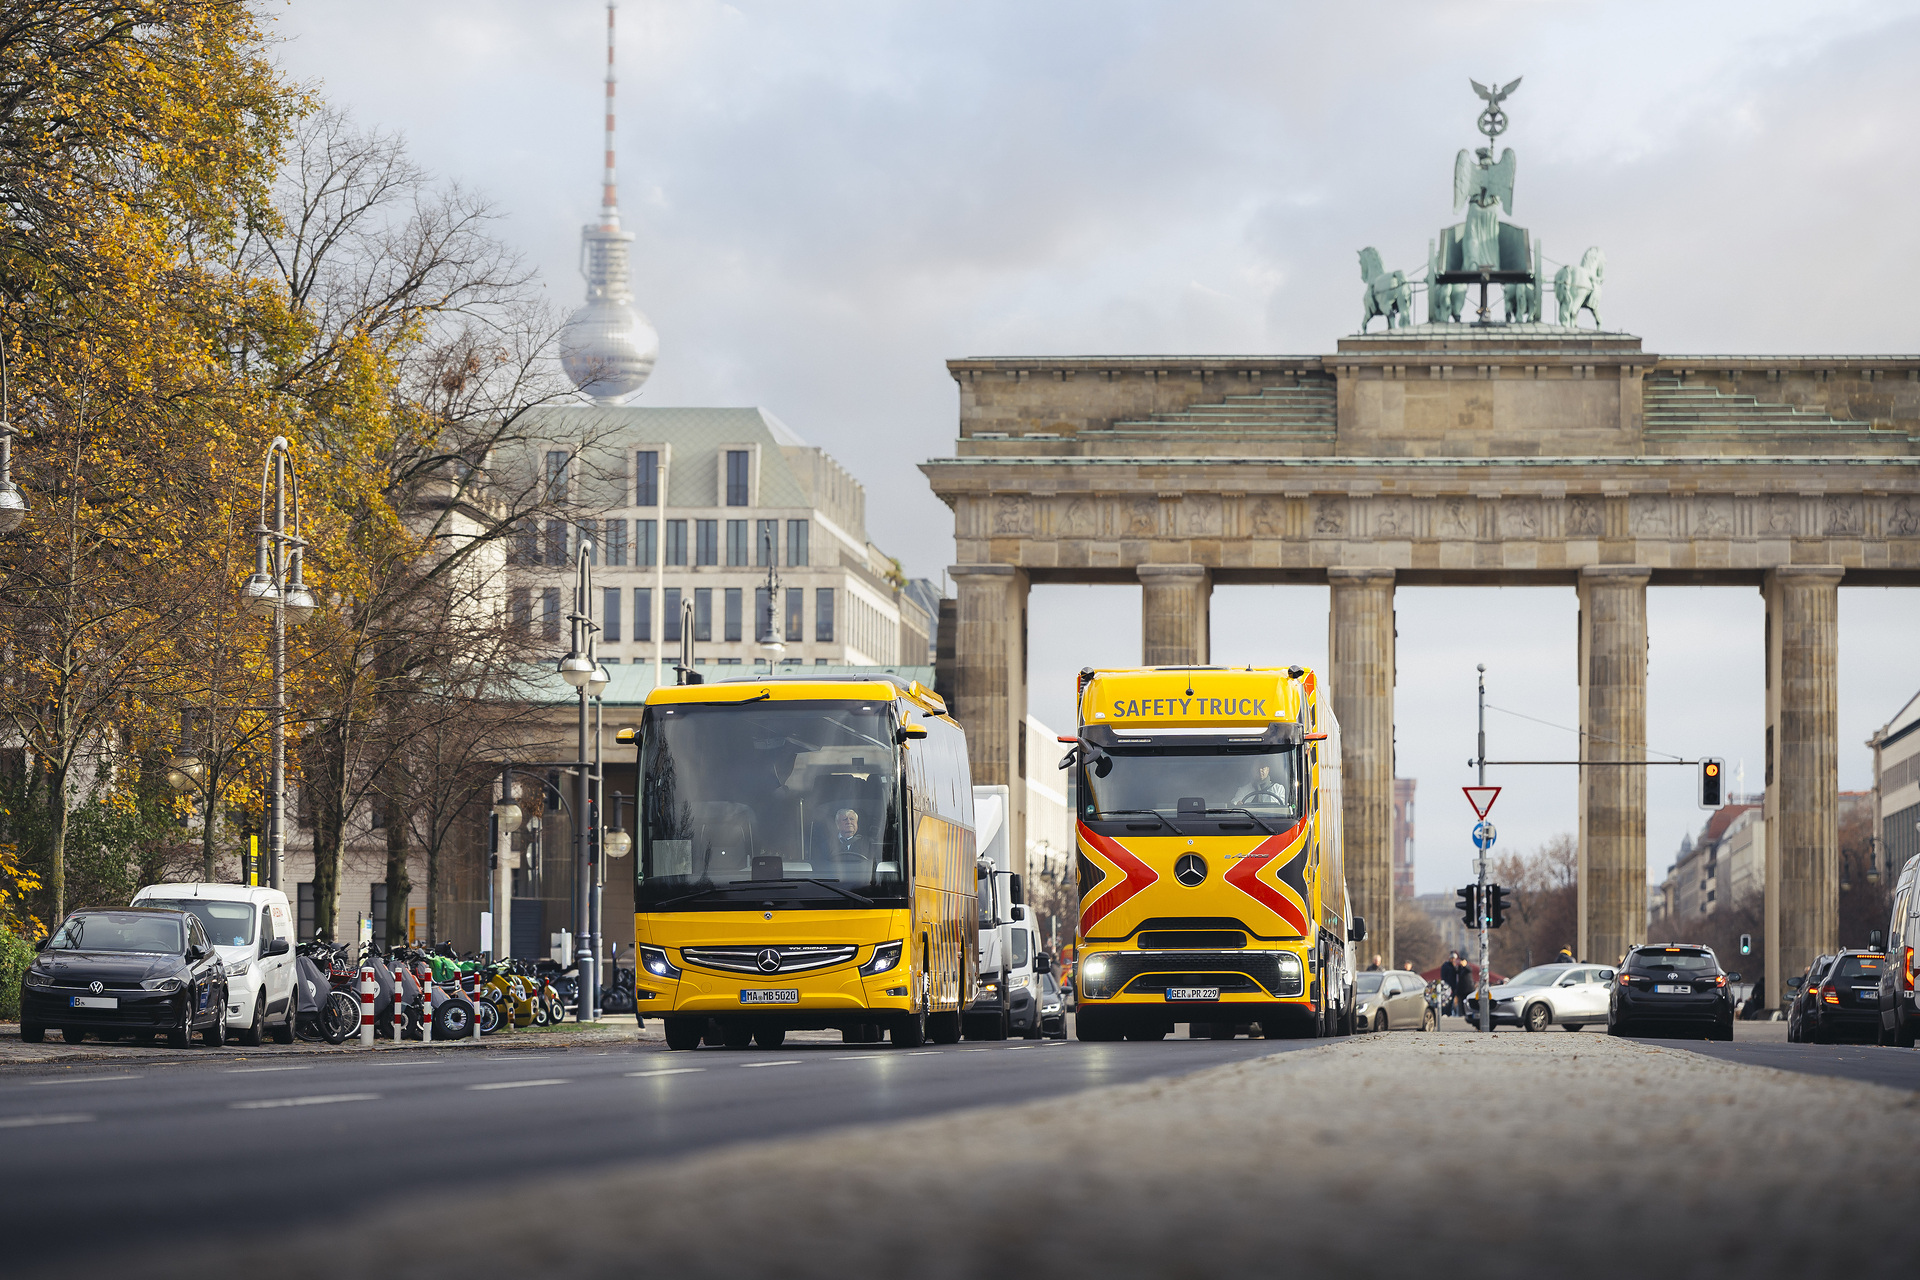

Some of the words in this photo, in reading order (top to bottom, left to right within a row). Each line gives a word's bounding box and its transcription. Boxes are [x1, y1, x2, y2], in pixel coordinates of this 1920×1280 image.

[1113, 698, 1192, 718] SAFETY
[1196, 698, 1267, 717] TRUCK
[746, 991, 758, 1001] MA
[762, 991, 774, 1001] MB
[775, 990, 796, 1000] 5020
[1172, 989, 1186, 998] GER
[1191, 989, 1202, 998] PR
[1203, 989, 1217, 998] 229
